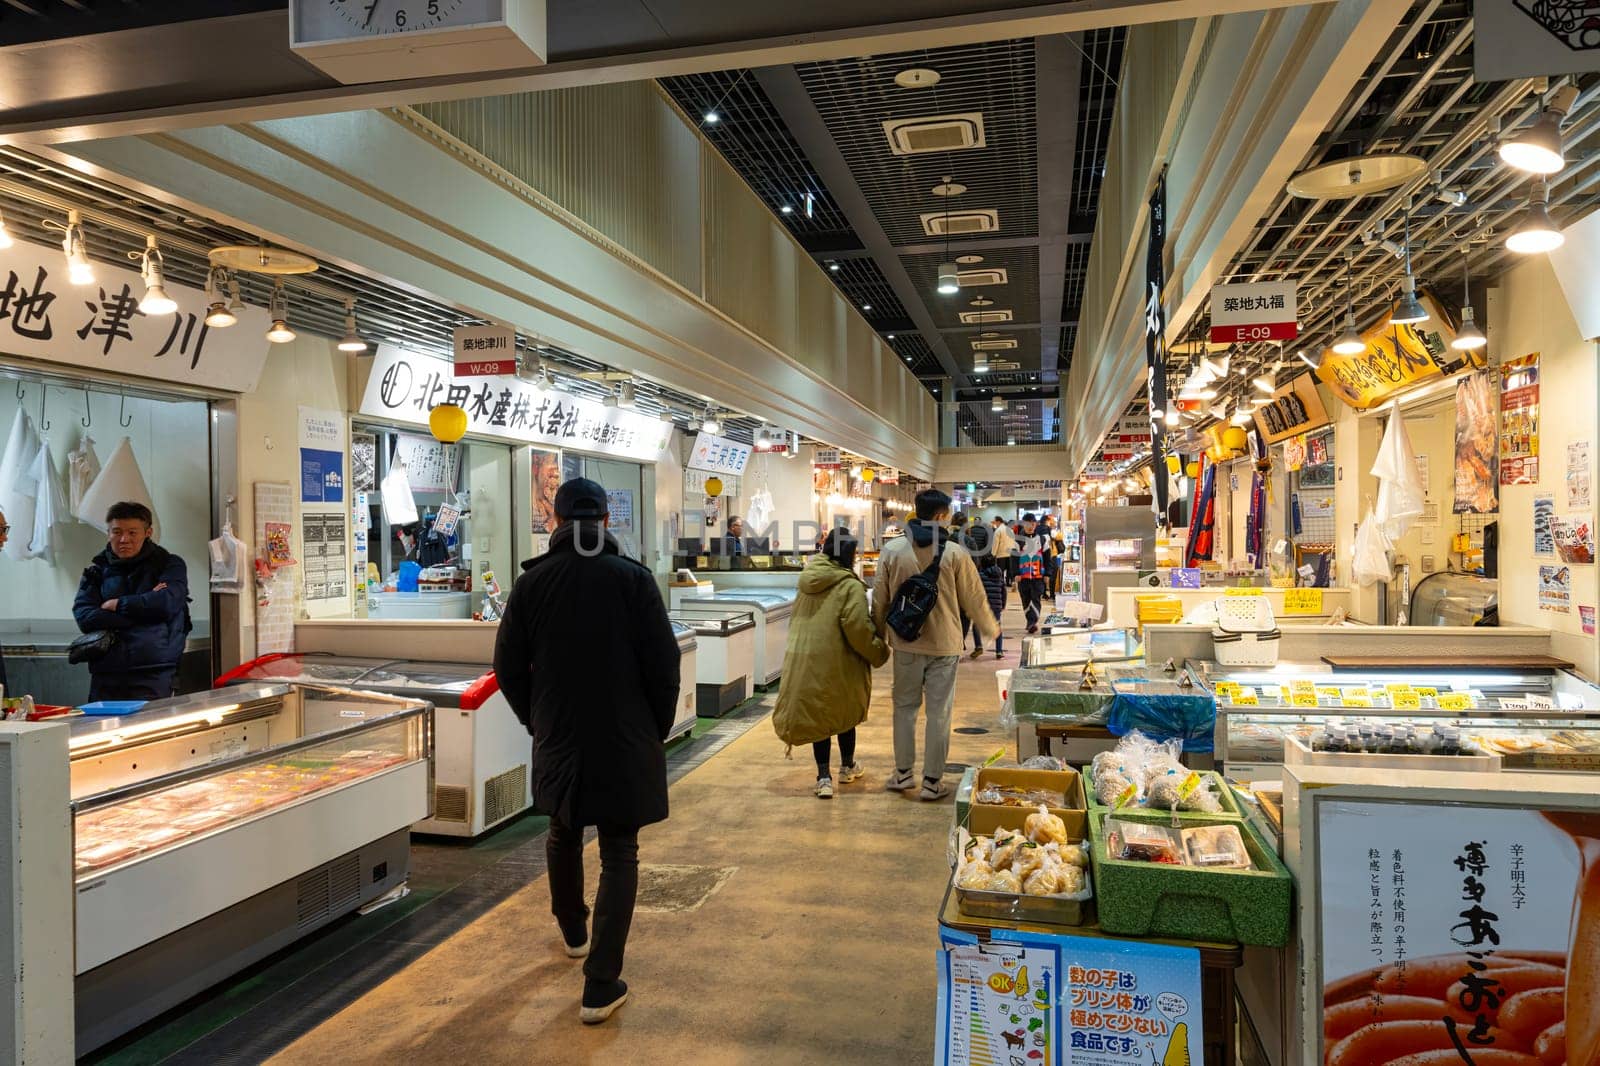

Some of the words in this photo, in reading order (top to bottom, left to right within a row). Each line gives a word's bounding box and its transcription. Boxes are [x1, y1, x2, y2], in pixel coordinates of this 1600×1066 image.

[395, 11, 407, 27] 6
[427, 0, 439, 15] 5
[1224, 294, 1285, 312] 築地丸福
[0, 266, 210, 370] 地津川
[463, 338, 506, 351] 築地津川
[1236, 327, 1271, 340] E-09
[470, 363, 499, 374] W-09
[413, 371, 580, 438] 北田水産株式会社
[707, 443, 747, 470] 三栄商店
[1510, 843, 1526, 910] 辛子明太子
[1391, 848, 1407, 995] 着色料不使用の辛子明
[991, 976, 1010, 990] OK
[1069, 966, 1136, 990] 数の子は
[1070, 988, 1150, 1013] プリン体が
[1069, 1008, 1168, 1036] 極めて少ない
[1070, 1030, 1141, 1056] 食品です。
